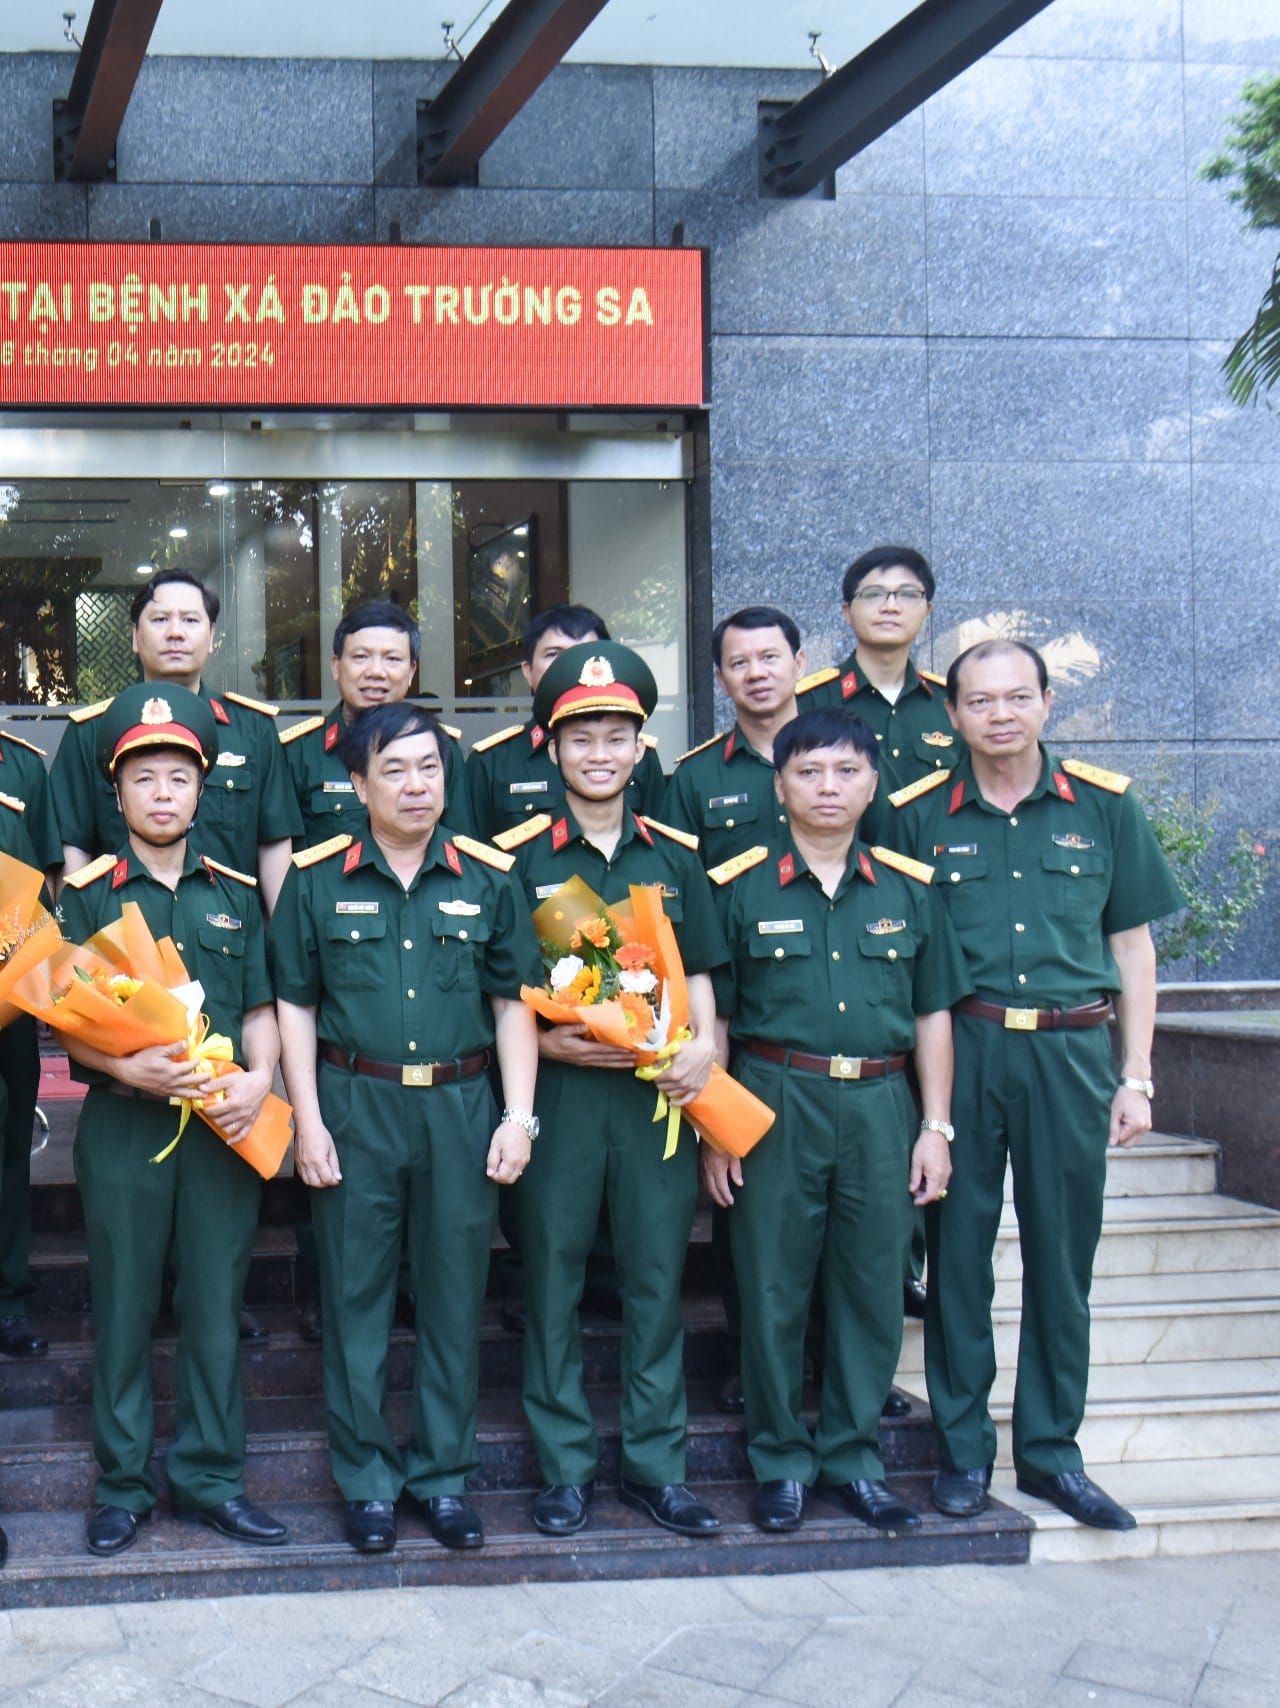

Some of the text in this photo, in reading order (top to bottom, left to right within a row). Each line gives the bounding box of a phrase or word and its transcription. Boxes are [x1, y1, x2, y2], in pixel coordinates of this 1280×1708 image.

[1, 281, 73, 335] TẠI
[89, 272, 209, 334] BỆNH
[224, 273, 286, 325] XÁ
[301, 271, 391, 325] ĐẢO
[405, 275, 582, 326] TRƯỜNG
[596, 286, 655, 327] SA
[107, 341, 138, 368] 04
[211, 341, 275, 367] 2024
